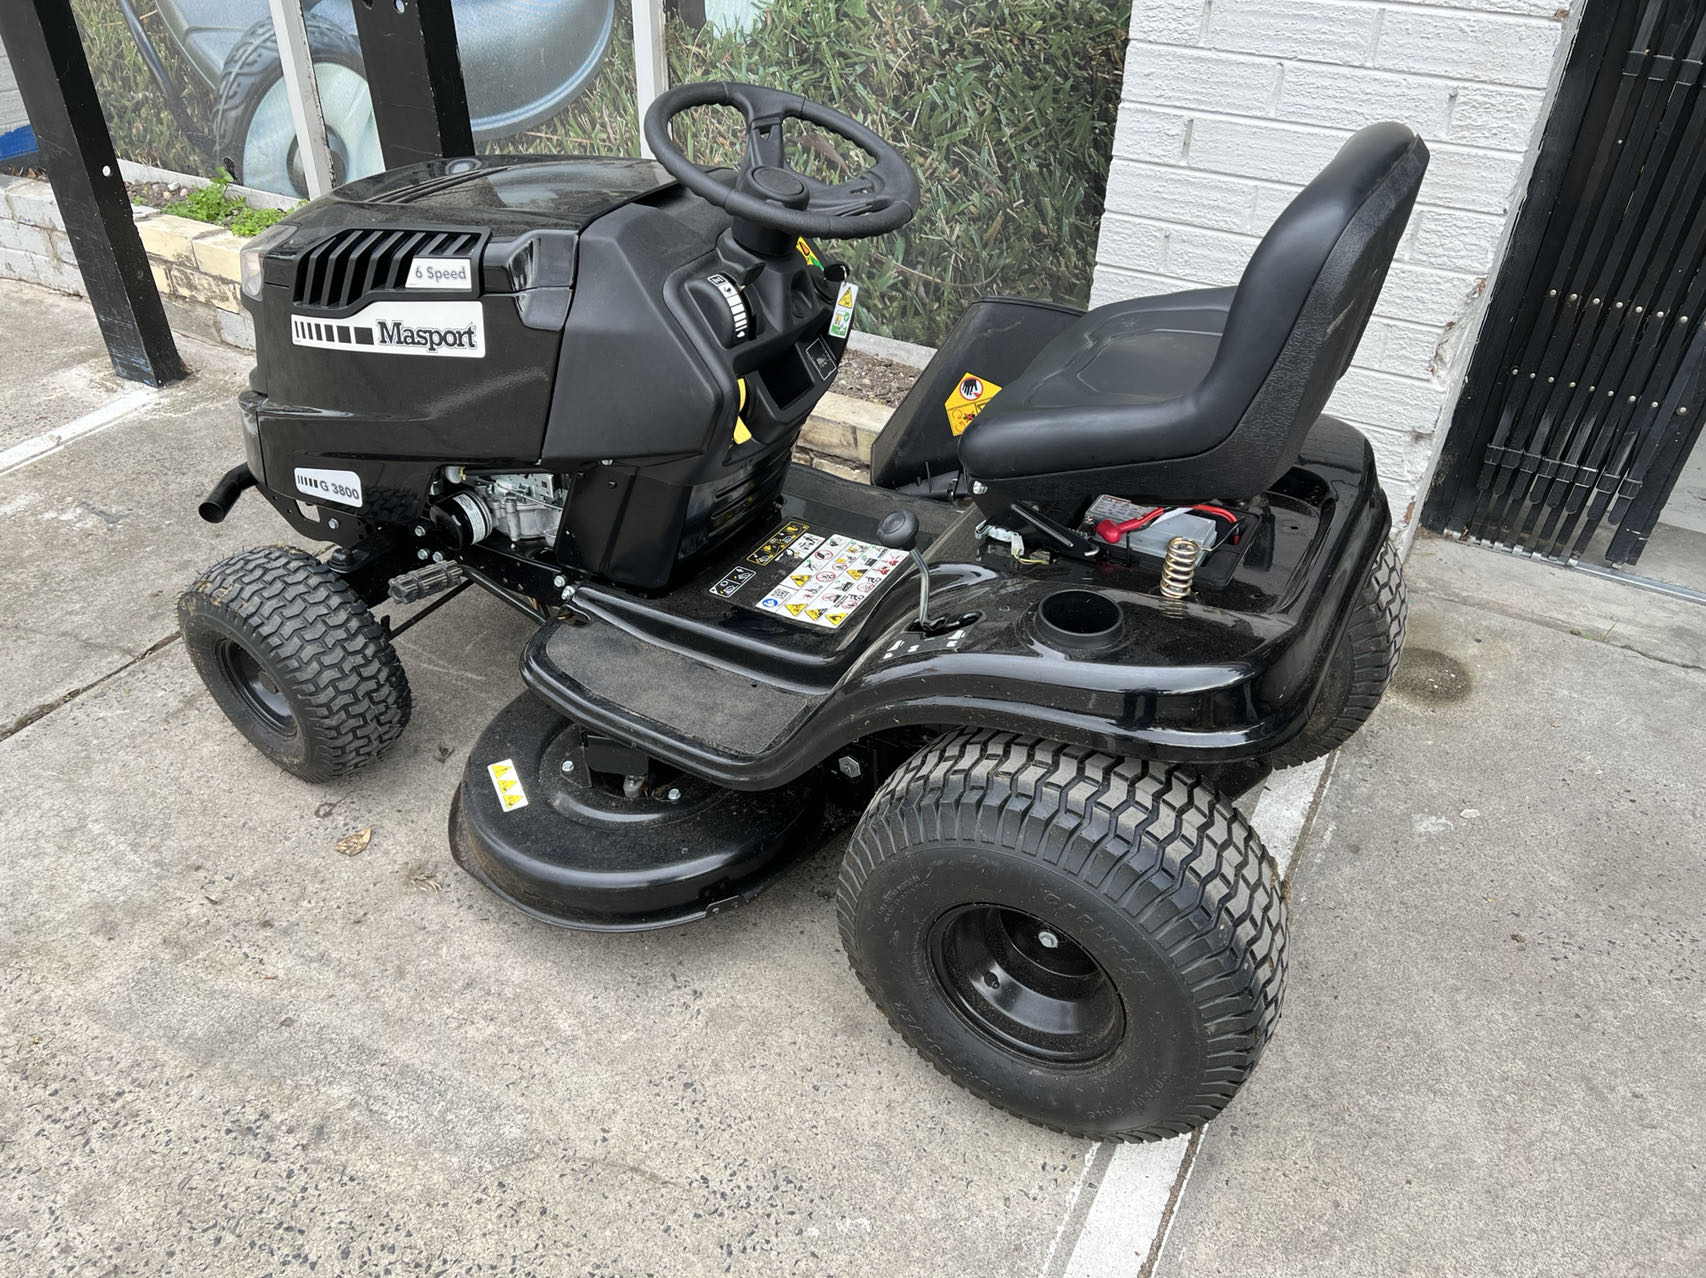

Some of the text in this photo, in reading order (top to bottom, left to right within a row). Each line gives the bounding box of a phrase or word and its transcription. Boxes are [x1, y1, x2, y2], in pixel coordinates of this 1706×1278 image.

[415, 265, 467, 283] 6 Speed
[377, 319, 477, 353] Masport
[320, 480, 360, 500] G 3800
